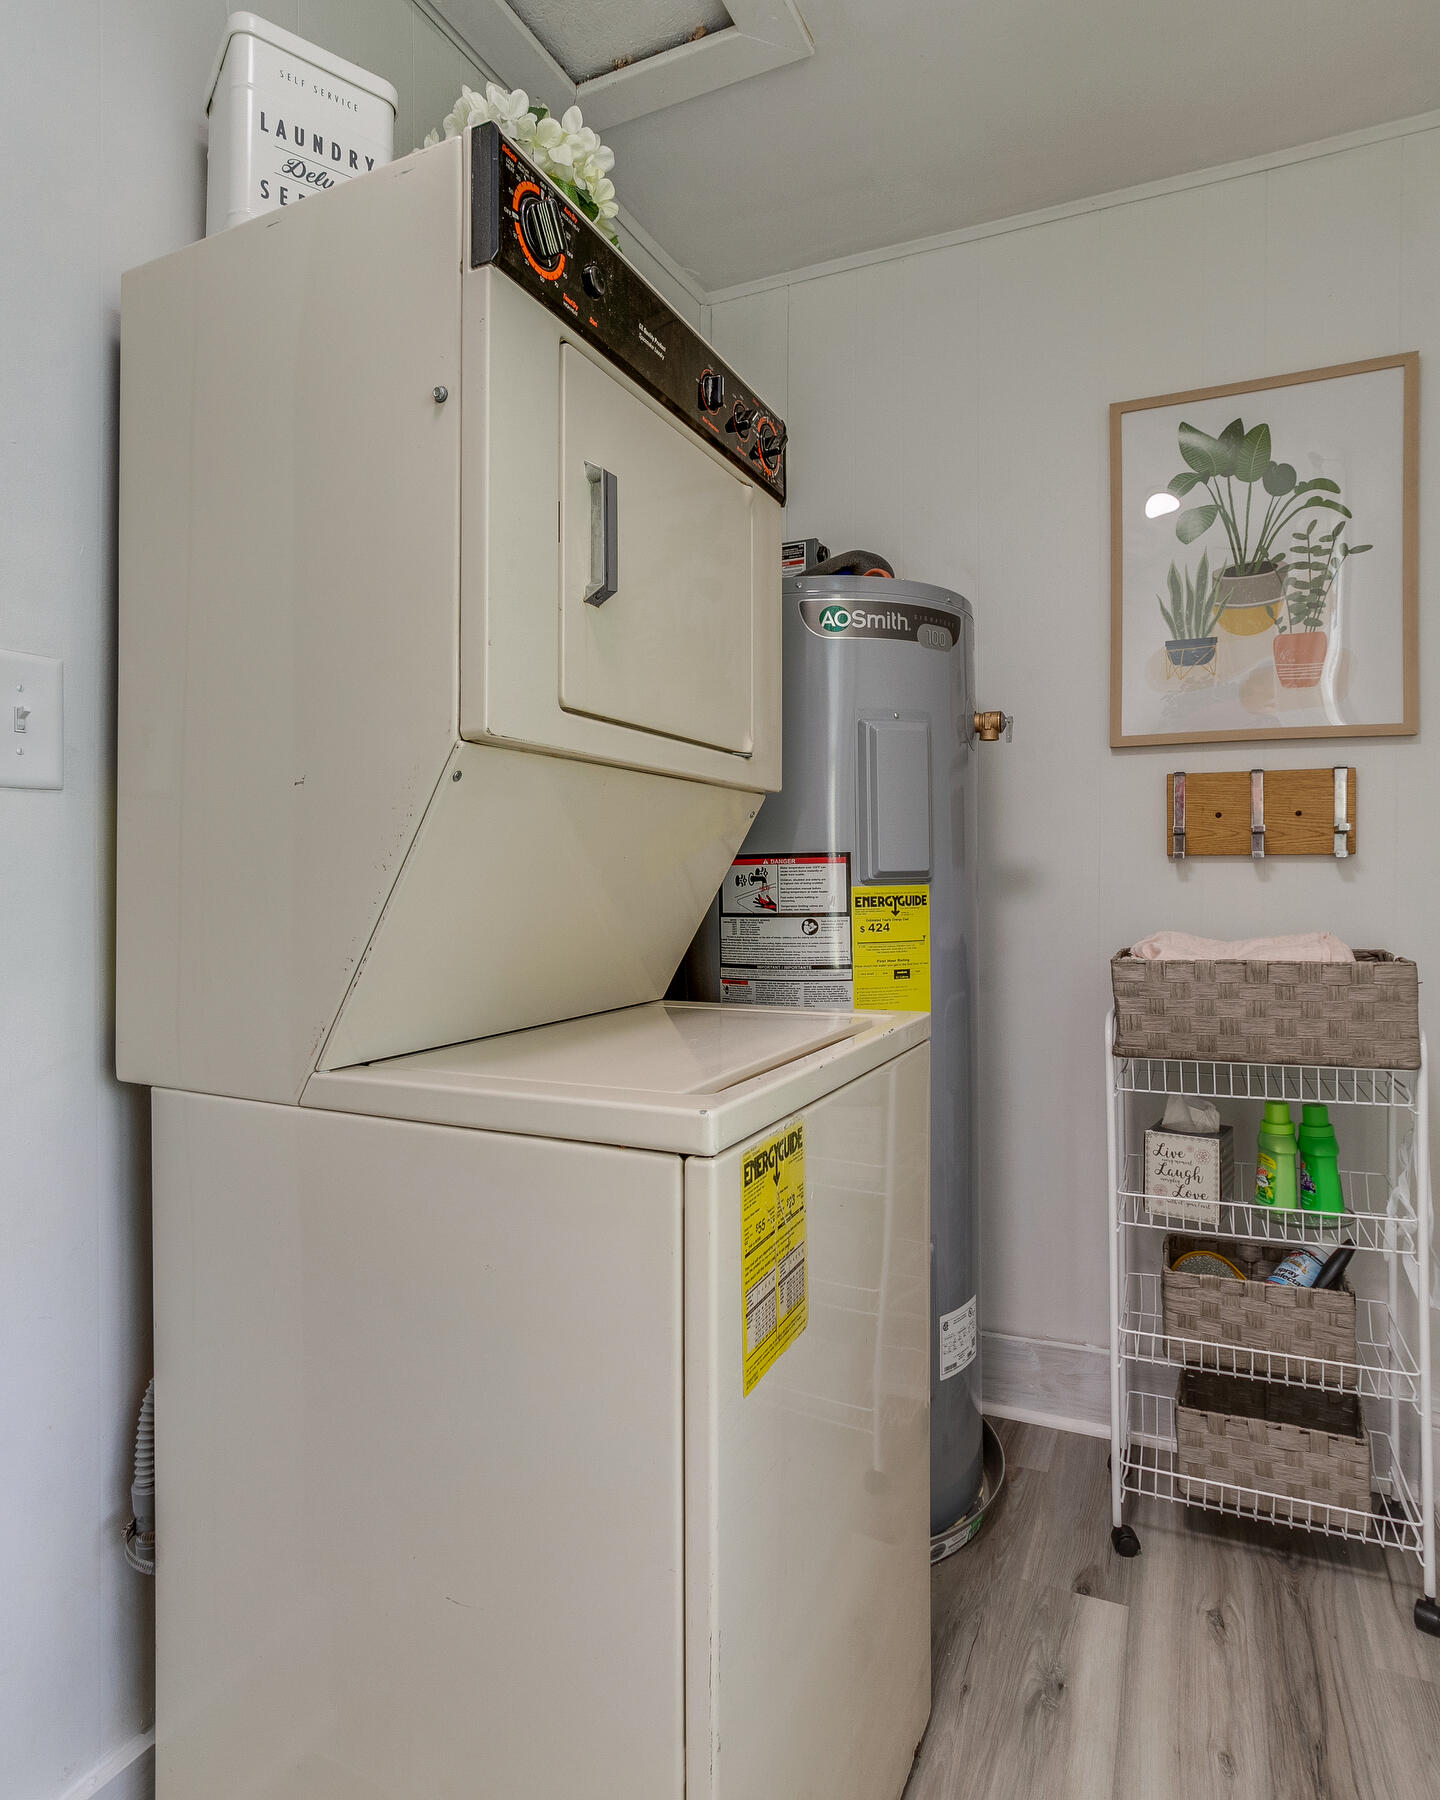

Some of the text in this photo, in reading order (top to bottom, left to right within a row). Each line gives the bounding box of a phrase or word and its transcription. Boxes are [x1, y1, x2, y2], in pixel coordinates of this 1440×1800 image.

[280, 70, 359, 112] SELF SERVICE
[260, 111, 375, 171] LAUNDRY
[868, 923, 890, 932] 424
[1153, 1143, 1185, 1158] Live
[1154, 1162, 1204, 1185] Laugh
[1172, 1184, 1209, 1200] Love
